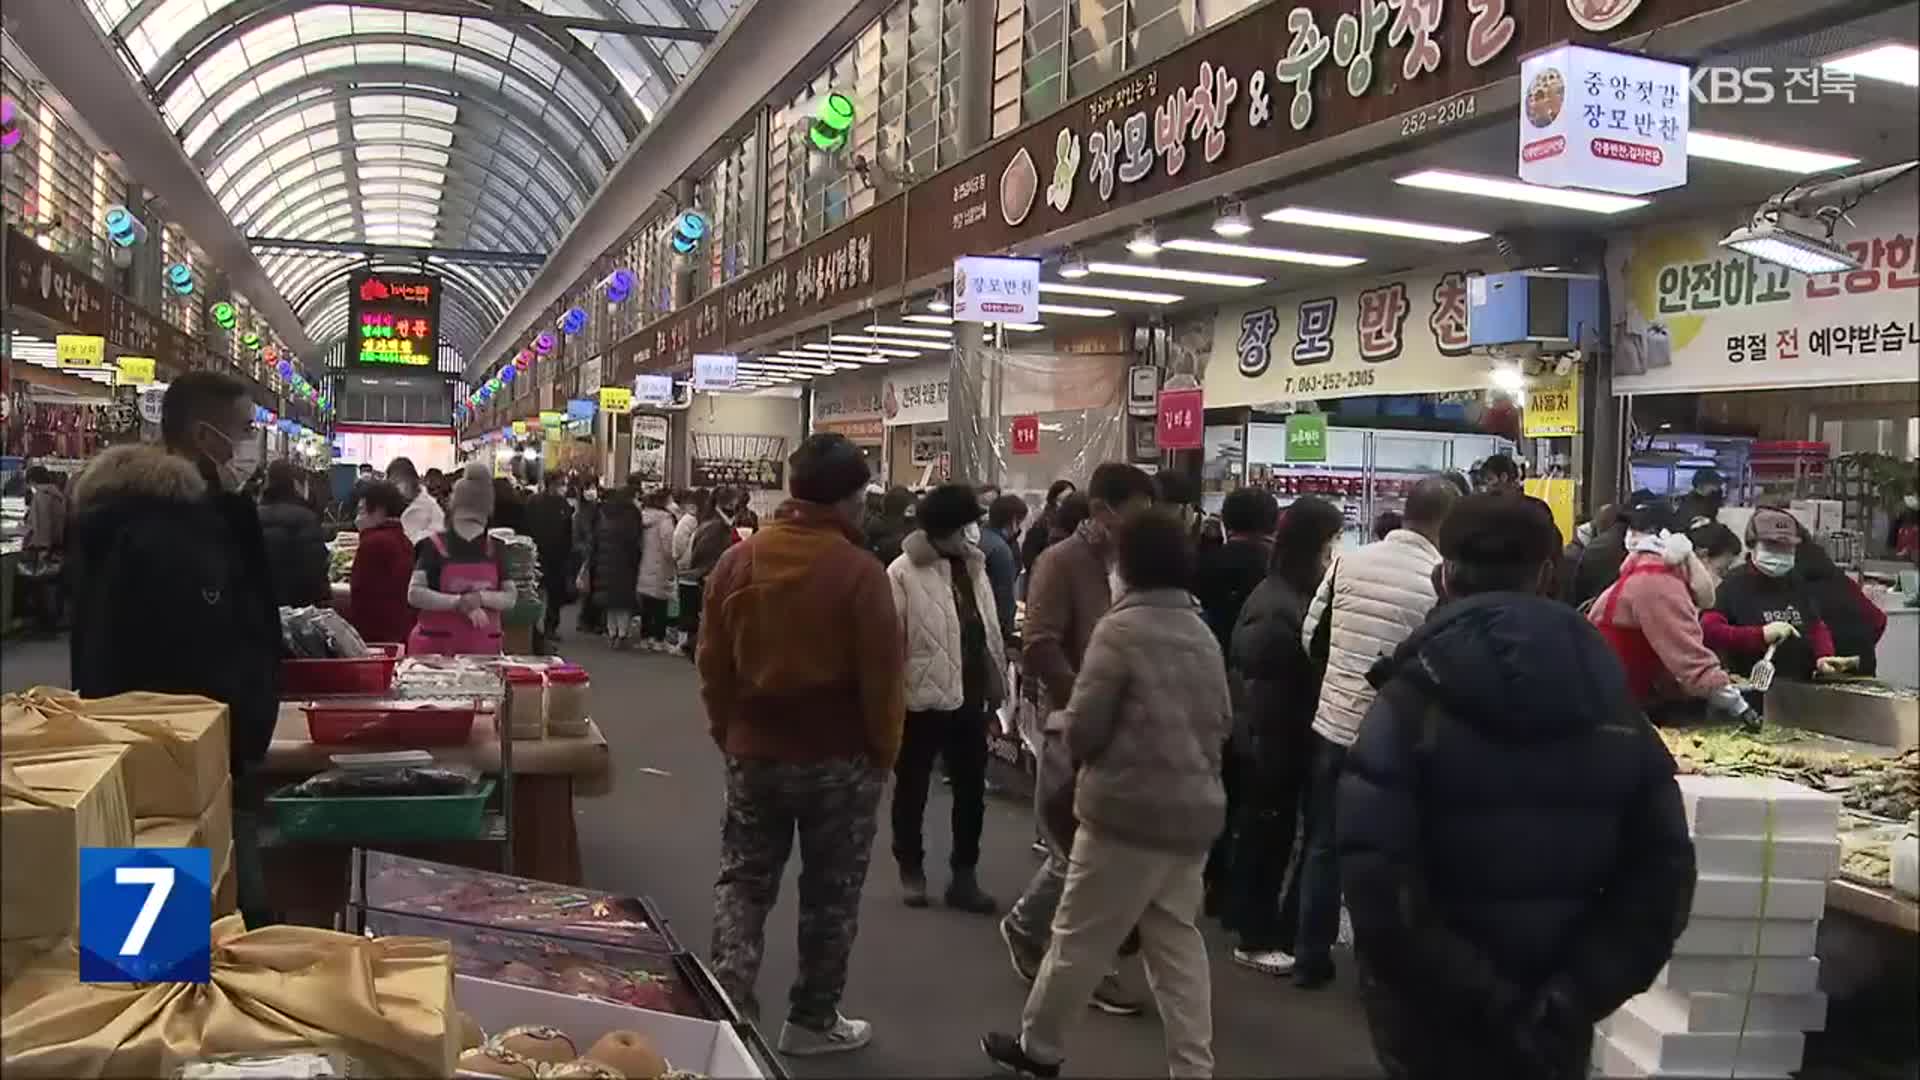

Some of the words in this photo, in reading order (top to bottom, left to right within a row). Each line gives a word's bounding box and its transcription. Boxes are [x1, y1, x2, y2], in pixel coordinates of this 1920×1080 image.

[1583, 71, 1681, 109] 중앙젓갈
[1089, 61, 1238, 200] 장모반찬
[1249, 69, 1270, 127] &
[1401, 96, 1476, 137] 252-2304
[1583, 104, 1680, 141] 장모반찬
[1806, 232, 1920, 299] 강한
[1727, 333, 1767, 363] 명절
[1776, 327, 1799, 360] 전
